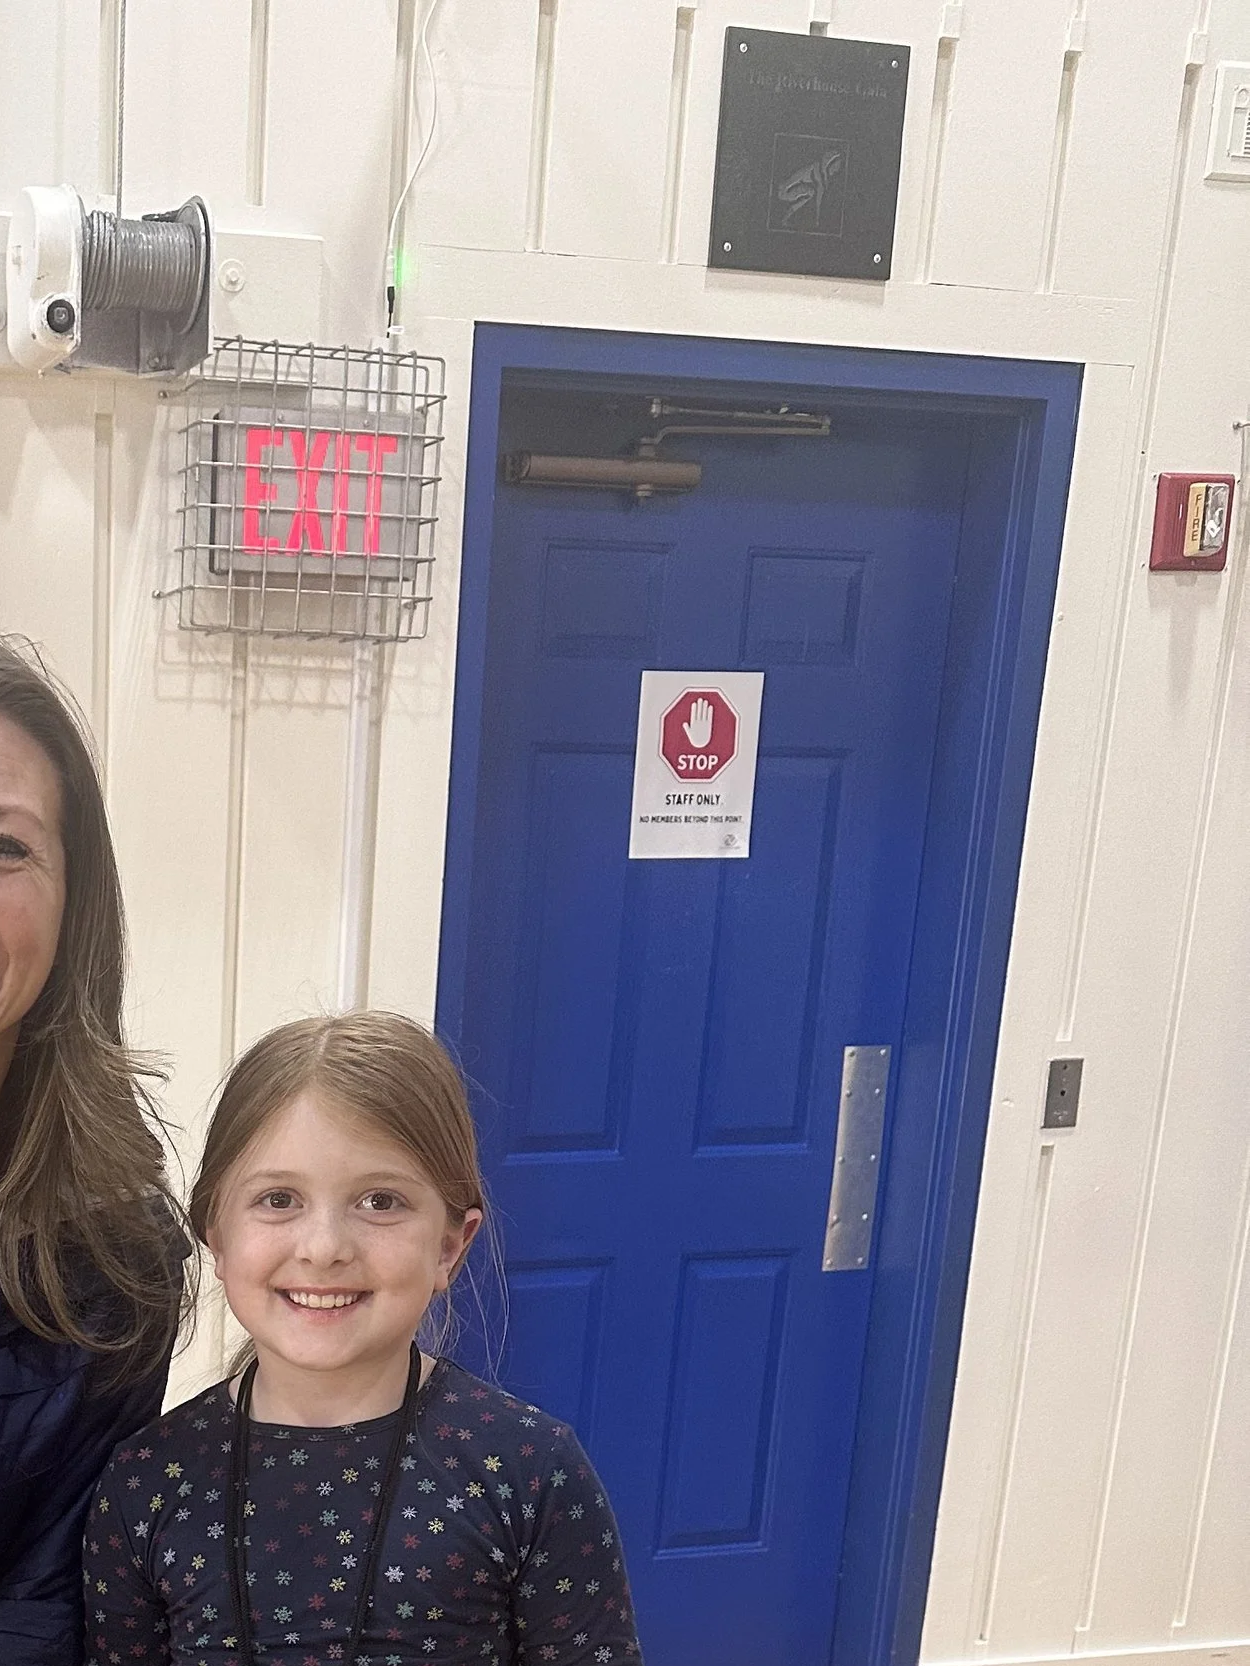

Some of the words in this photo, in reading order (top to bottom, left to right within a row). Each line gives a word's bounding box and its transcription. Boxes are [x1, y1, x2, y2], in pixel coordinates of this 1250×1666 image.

[243, 429, 397, 557] EXIT
[1191, 494, 1202, 541] FIRE
[677, 754, 718, 771] STOP
[665, 793, 694, 806] STAFF
[639, 815, 649, 823] NO
[651, 815, 682, 824] MEMBERS
[684, 815, 709, 824] BEYOND
[710, 815, 723, 824] THIS
